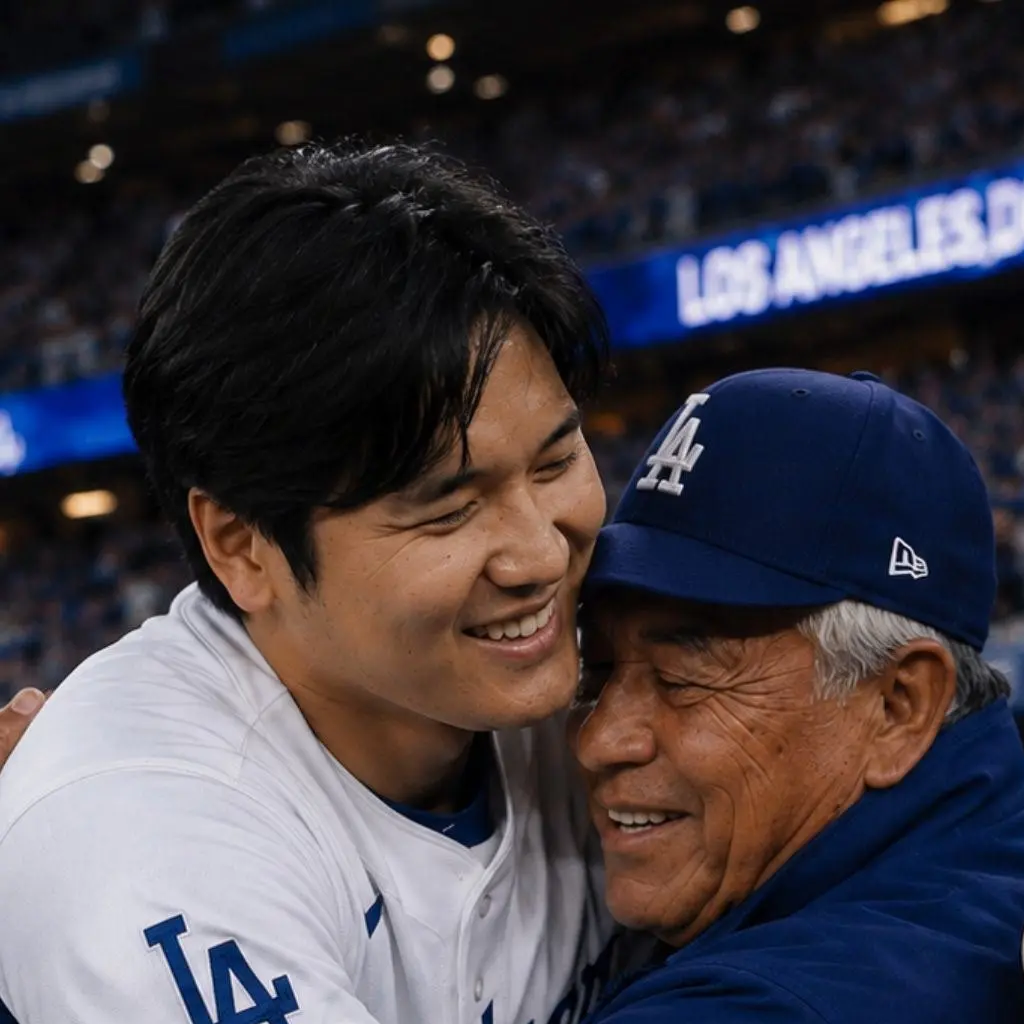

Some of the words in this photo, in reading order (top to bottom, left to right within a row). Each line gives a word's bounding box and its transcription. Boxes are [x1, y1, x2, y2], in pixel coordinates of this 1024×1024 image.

[677, 239, 772, 328] LOS
[771, 187, 986, 309] ANGELES
[637, 393, 709, 496] LA
